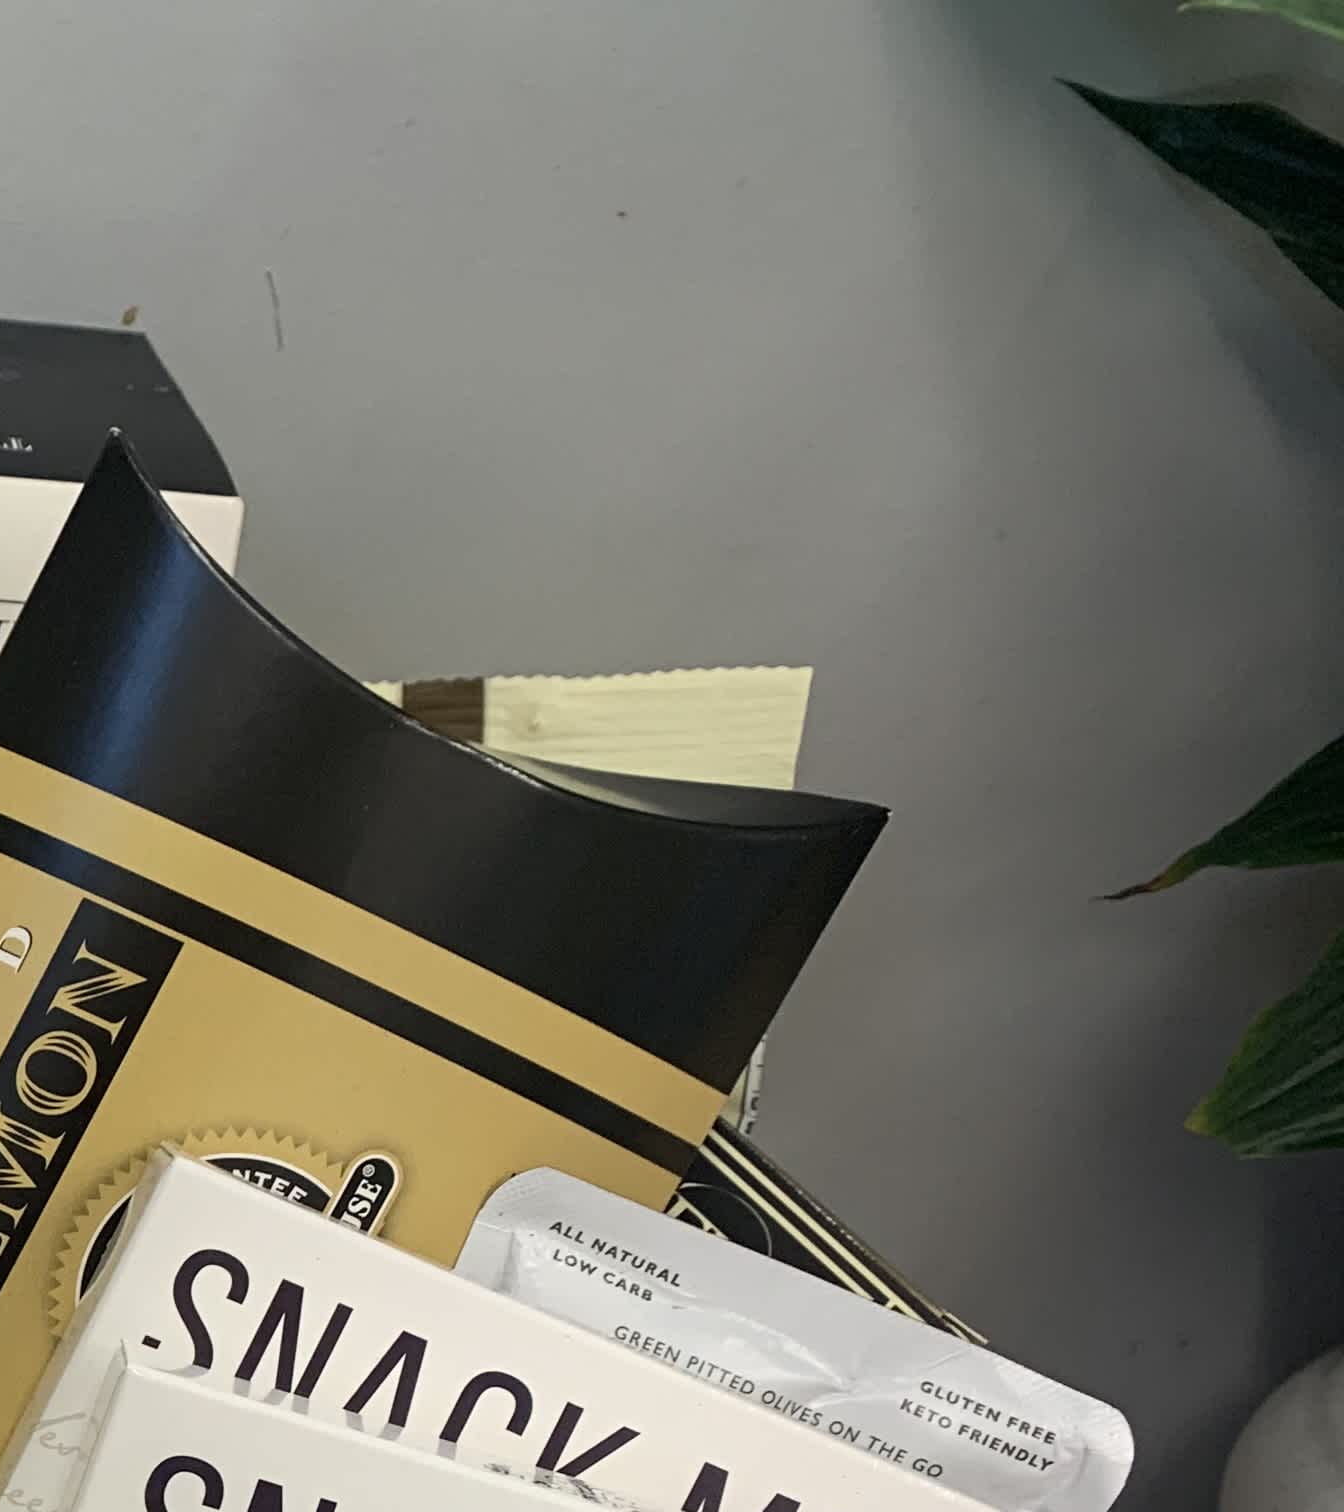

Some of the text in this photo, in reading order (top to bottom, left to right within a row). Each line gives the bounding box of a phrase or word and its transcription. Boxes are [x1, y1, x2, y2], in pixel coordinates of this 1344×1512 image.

[549, 1220, 683, 1287] ALL NATURAL
[552, 1248, 654, 1302] LOW CARB
[613, 1324, 944, 1479] GREEN PITTED OLIVES ON THE GO
[899, 1397, 1055, 1472] KETO FRIENDLY
[919, 1380, 1057, 1446] GLUTEN FREE
